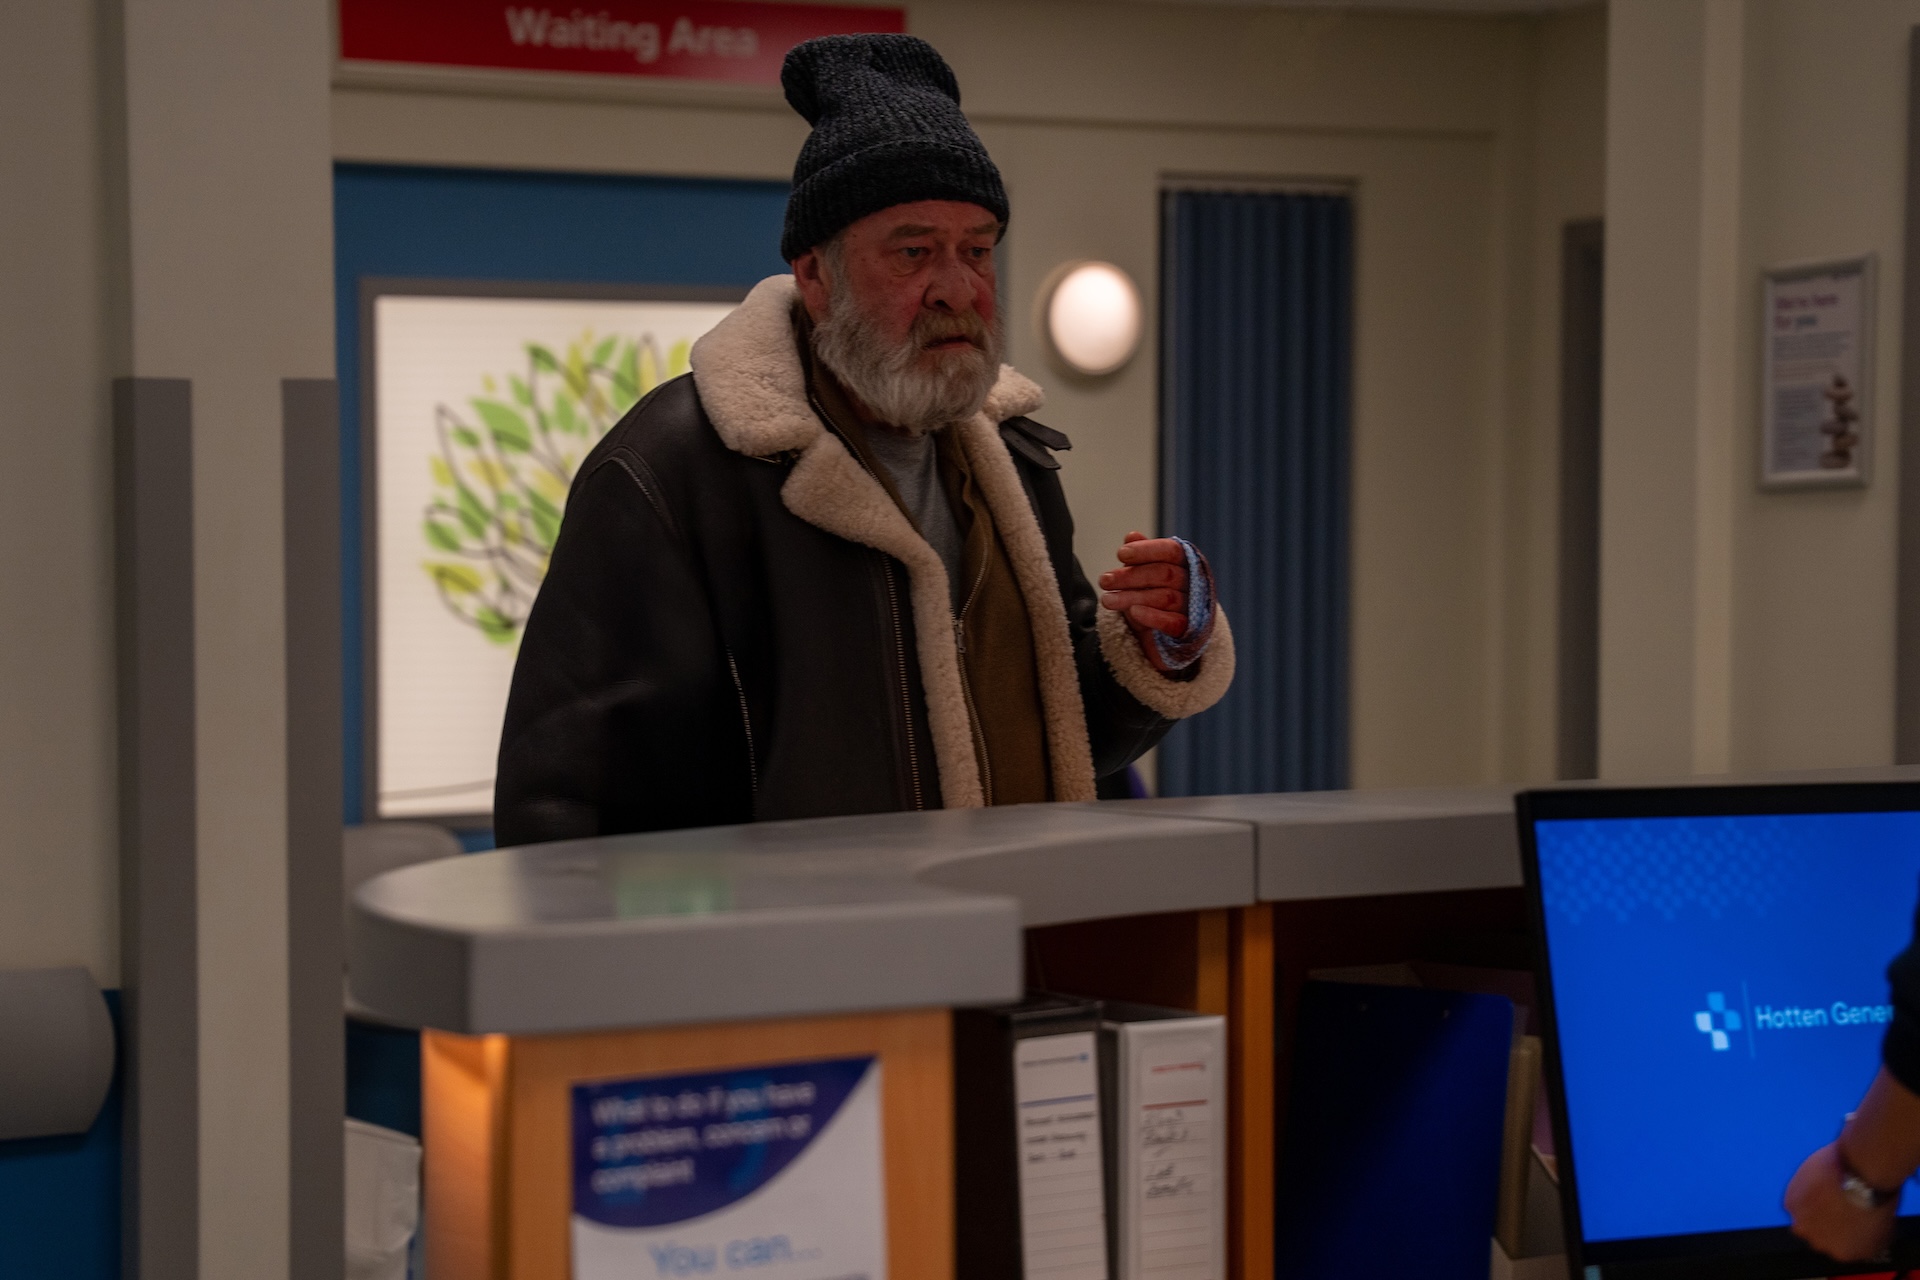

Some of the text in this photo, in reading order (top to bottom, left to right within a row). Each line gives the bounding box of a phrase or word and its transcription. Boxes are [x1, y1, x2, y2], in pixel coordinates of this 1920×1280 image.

[505, 8, 758, 62] Waiting Area
[1755, 1005, 1828, 1029] Hotten
[592, 1081, 816, 1128] What to do if you have
[703, 1118, 783, 1148] concern
[786, 1115, 811, 1140] or
[591, 1159, 695, 1195] complaint
[649, 1242, 717, 1276] You
